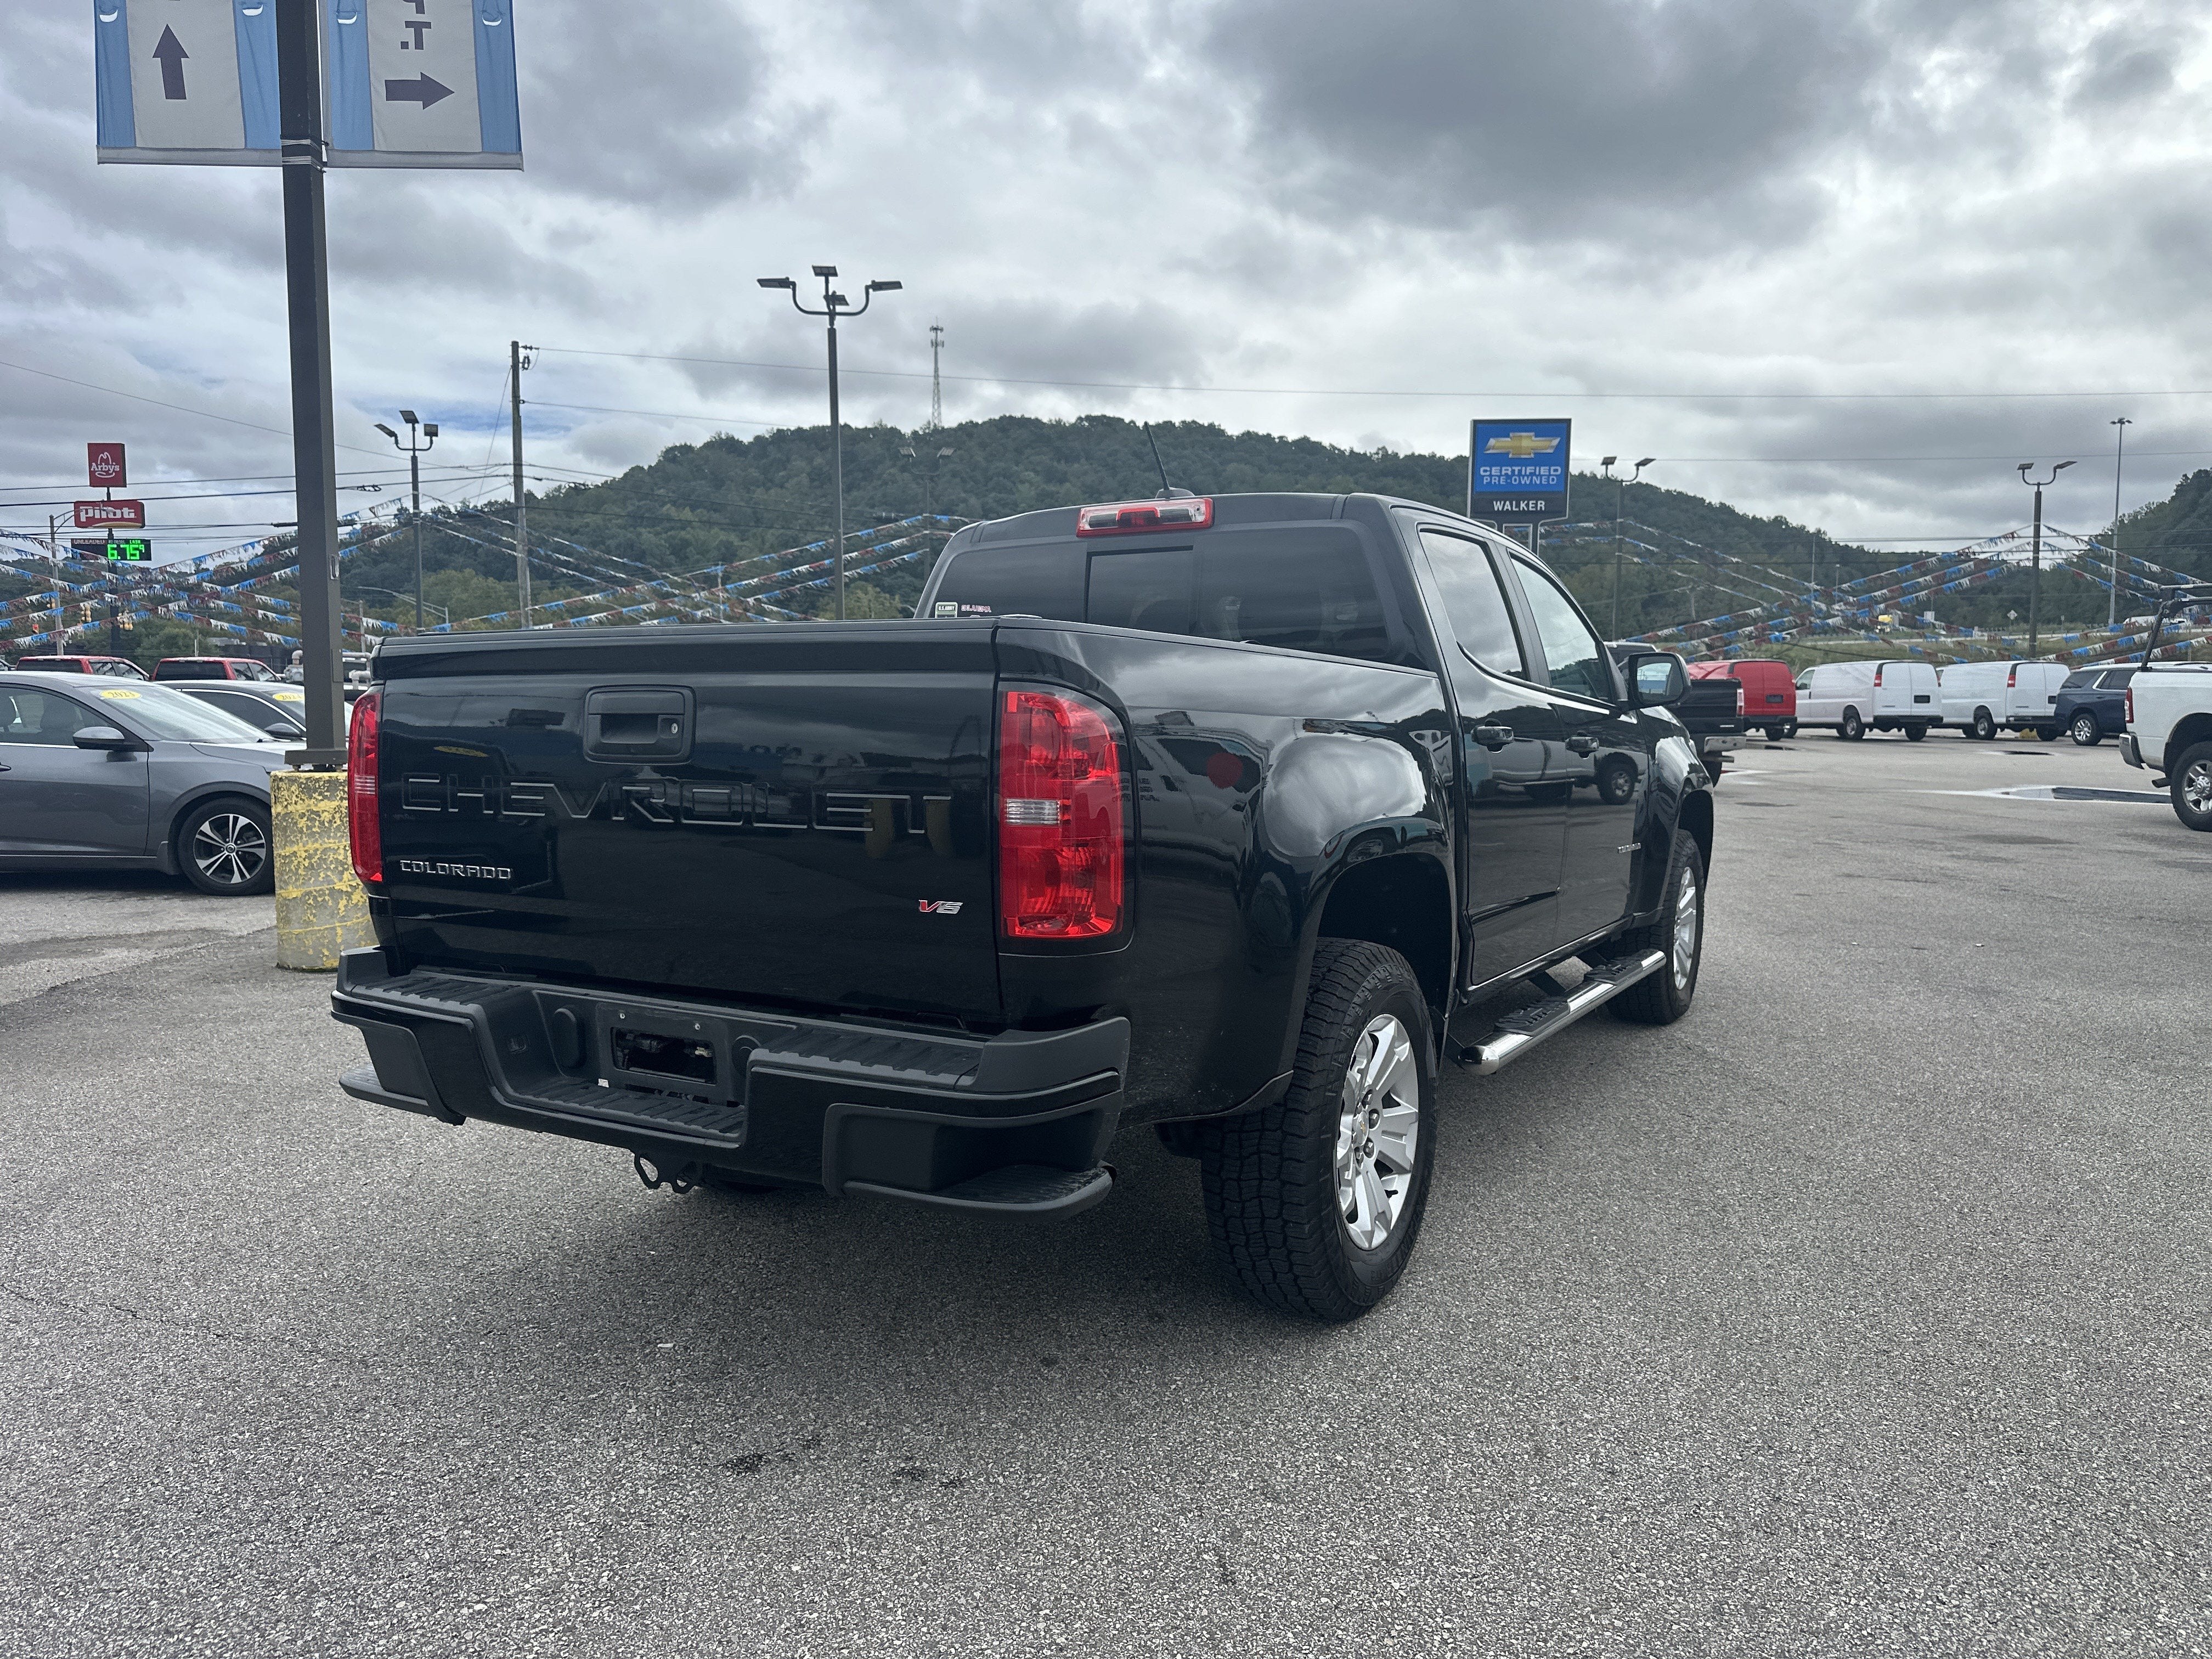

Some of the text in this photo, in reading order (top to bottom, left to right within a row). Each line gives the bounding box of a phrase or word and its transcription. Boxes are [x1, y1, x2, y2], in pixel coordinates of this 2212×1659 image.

[91, 463, 120, 473] Arby's
[1480, 466, 1561, 476] CERTIFIED
[1483, 476, 1557, 484] PRE-OWNED
[1493, 500, 1545, 511] WALKER
[402, 771, 952, 834] CHEVROLET
[400, 860, 513, 880] COLORADO
[918, 899, 963, 915] V6
